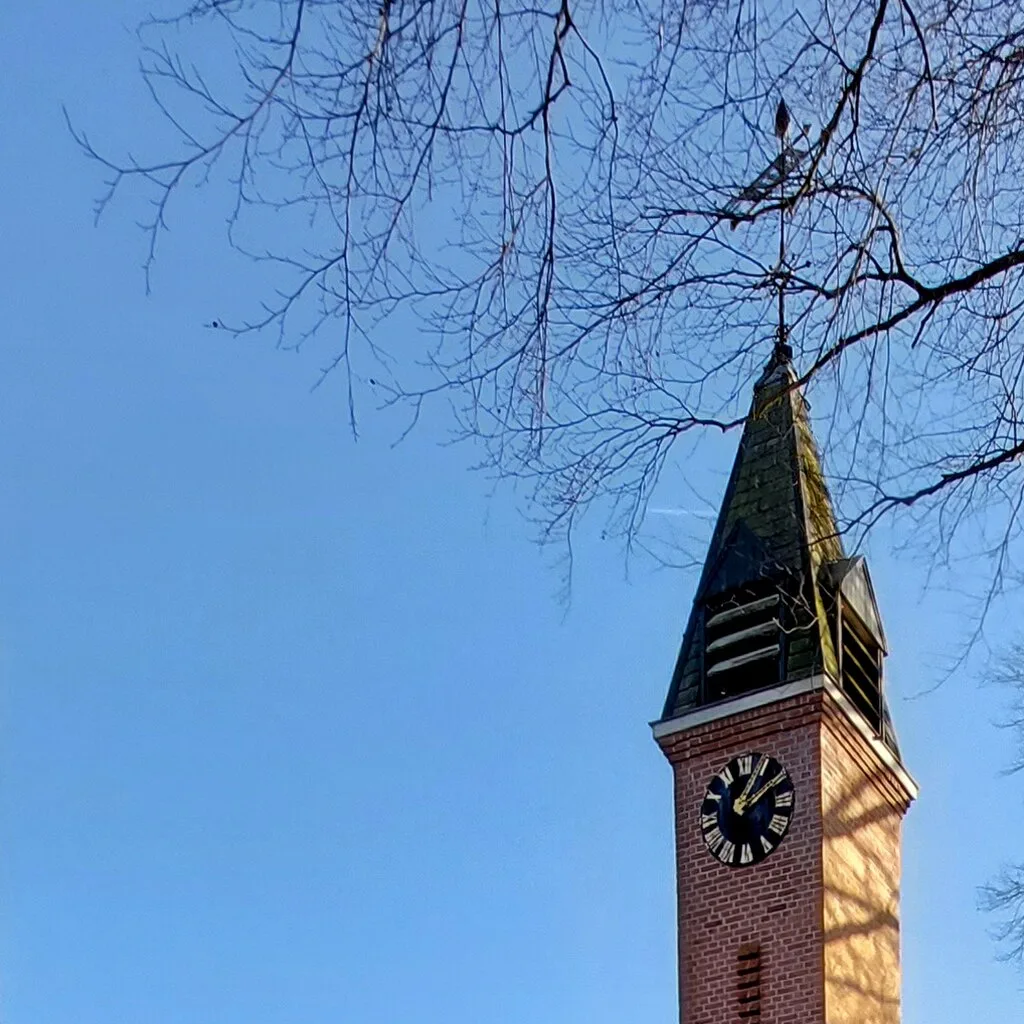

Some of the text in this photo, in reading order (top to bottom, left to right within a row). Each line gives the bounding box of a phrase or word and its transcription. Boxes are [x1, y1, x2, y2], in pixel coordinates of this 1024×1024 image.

[737, 755, 753, 776] XII
[719, 766, 734, 788] XI
[706, 790, 722, 802] X
[775, 792, 793, 807] III
[702, 812, 718, 829] IX
[760, 835, 773, 853] V
[740, 843, 753, 864] VI
